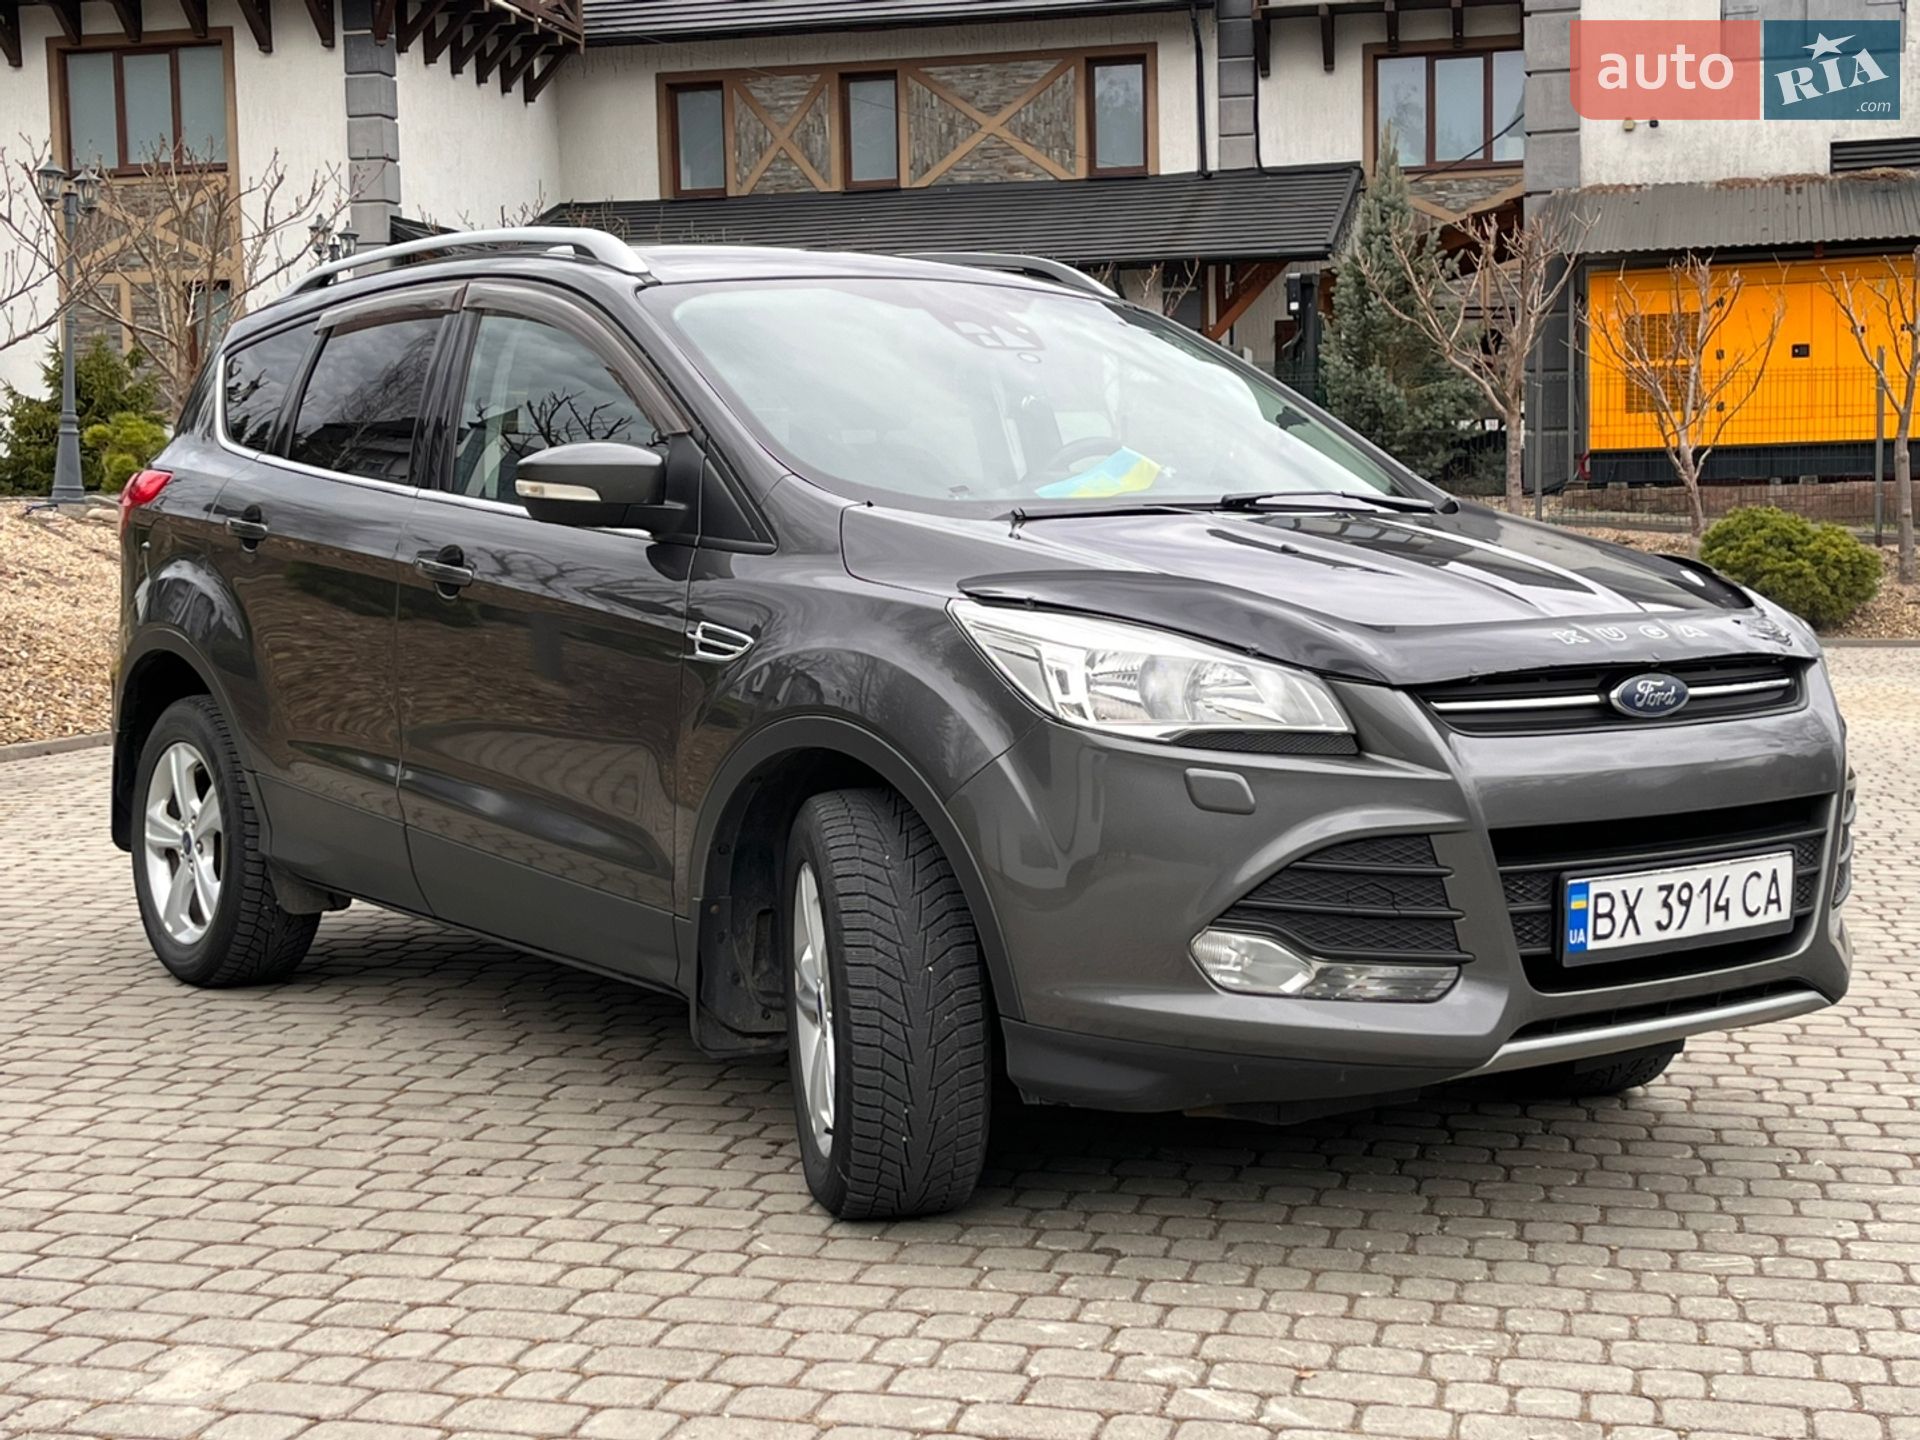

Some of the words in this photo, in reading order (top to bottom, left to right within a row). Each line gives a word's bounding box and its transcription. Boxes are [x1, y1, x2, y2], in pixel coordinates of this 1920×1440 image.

[1552, 624, 1709, 645] KUGA
[1634, 679, 1677, 708] Ford
[1592, 887, 1644, 941] BX
[1655, 874, 1730, 932] 3914
[1742, 868, 1782, 918] CA
[1569, 929, 1586, 945] UA
